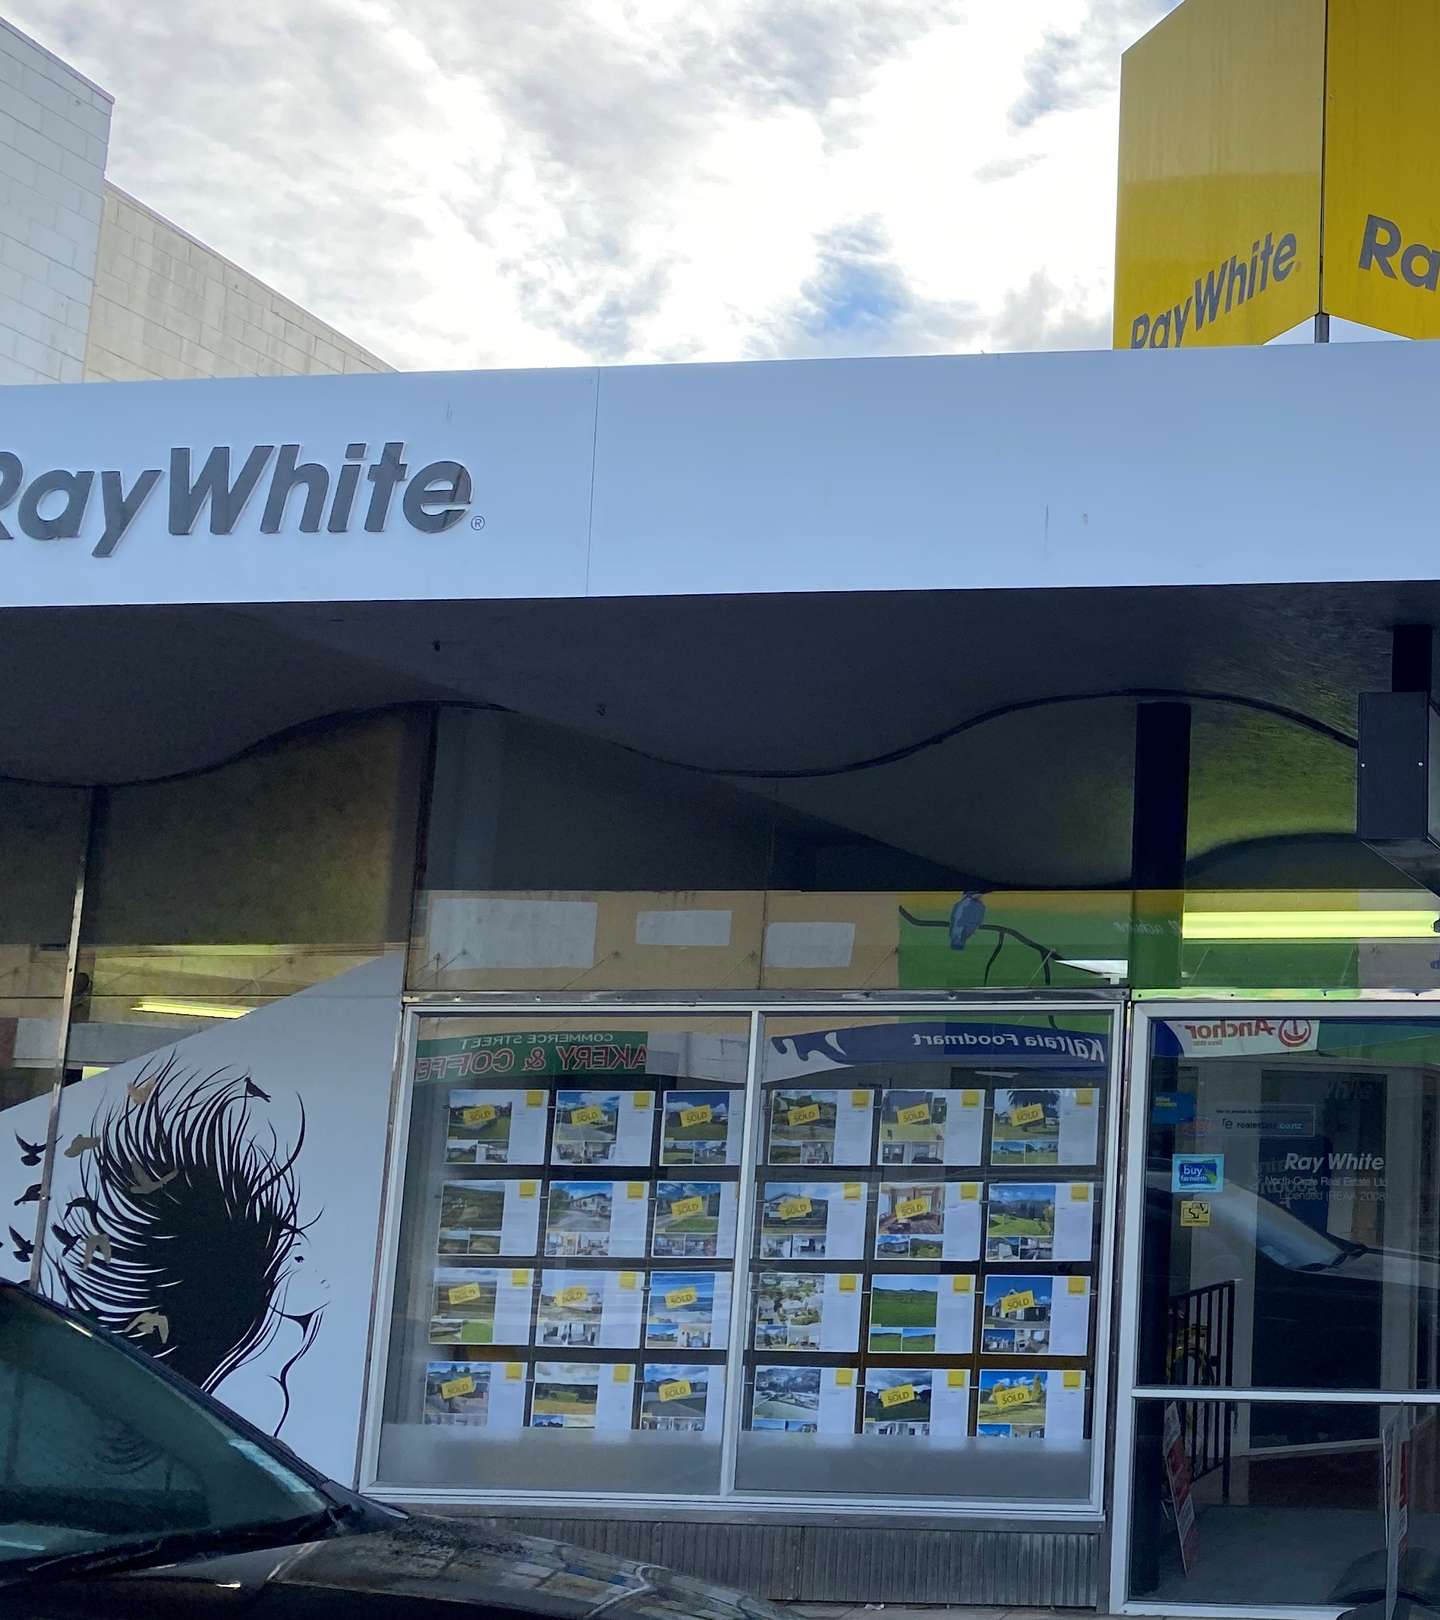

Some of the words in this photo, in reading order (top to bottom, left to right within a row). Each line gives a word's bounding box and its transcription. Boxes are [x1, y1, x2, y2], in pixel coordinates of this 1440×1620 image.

[468, 1111, 491, 1122] SOLD
[575, 1112, 597, 1122] SOLD
[686, 1112, 707, 1123] SOLD
[793, 1111, 816, 1121] SOLD
[903, 1111, 925, 1122] SOLD
[1016, 1111, 1038, 1122] SOLD
[1284, 1152, 1325, 1173] Ray
[1328, 1152, 1385, 1171] White
[1183, 1164, 1203, 1176] buy
[901, 1205, 922, 1216] SOLD
[670, 1295, 692, 1305] SOLD
[1007, 1297, 1029, 1309] SOLD
[447, 1384, 469, 1394] SOLD
[664, 1387, 686, 1397] SOLD
[888, 1392, 909, 1403] SOLD
[1002, 1392, 1024, 1404] SOLD
